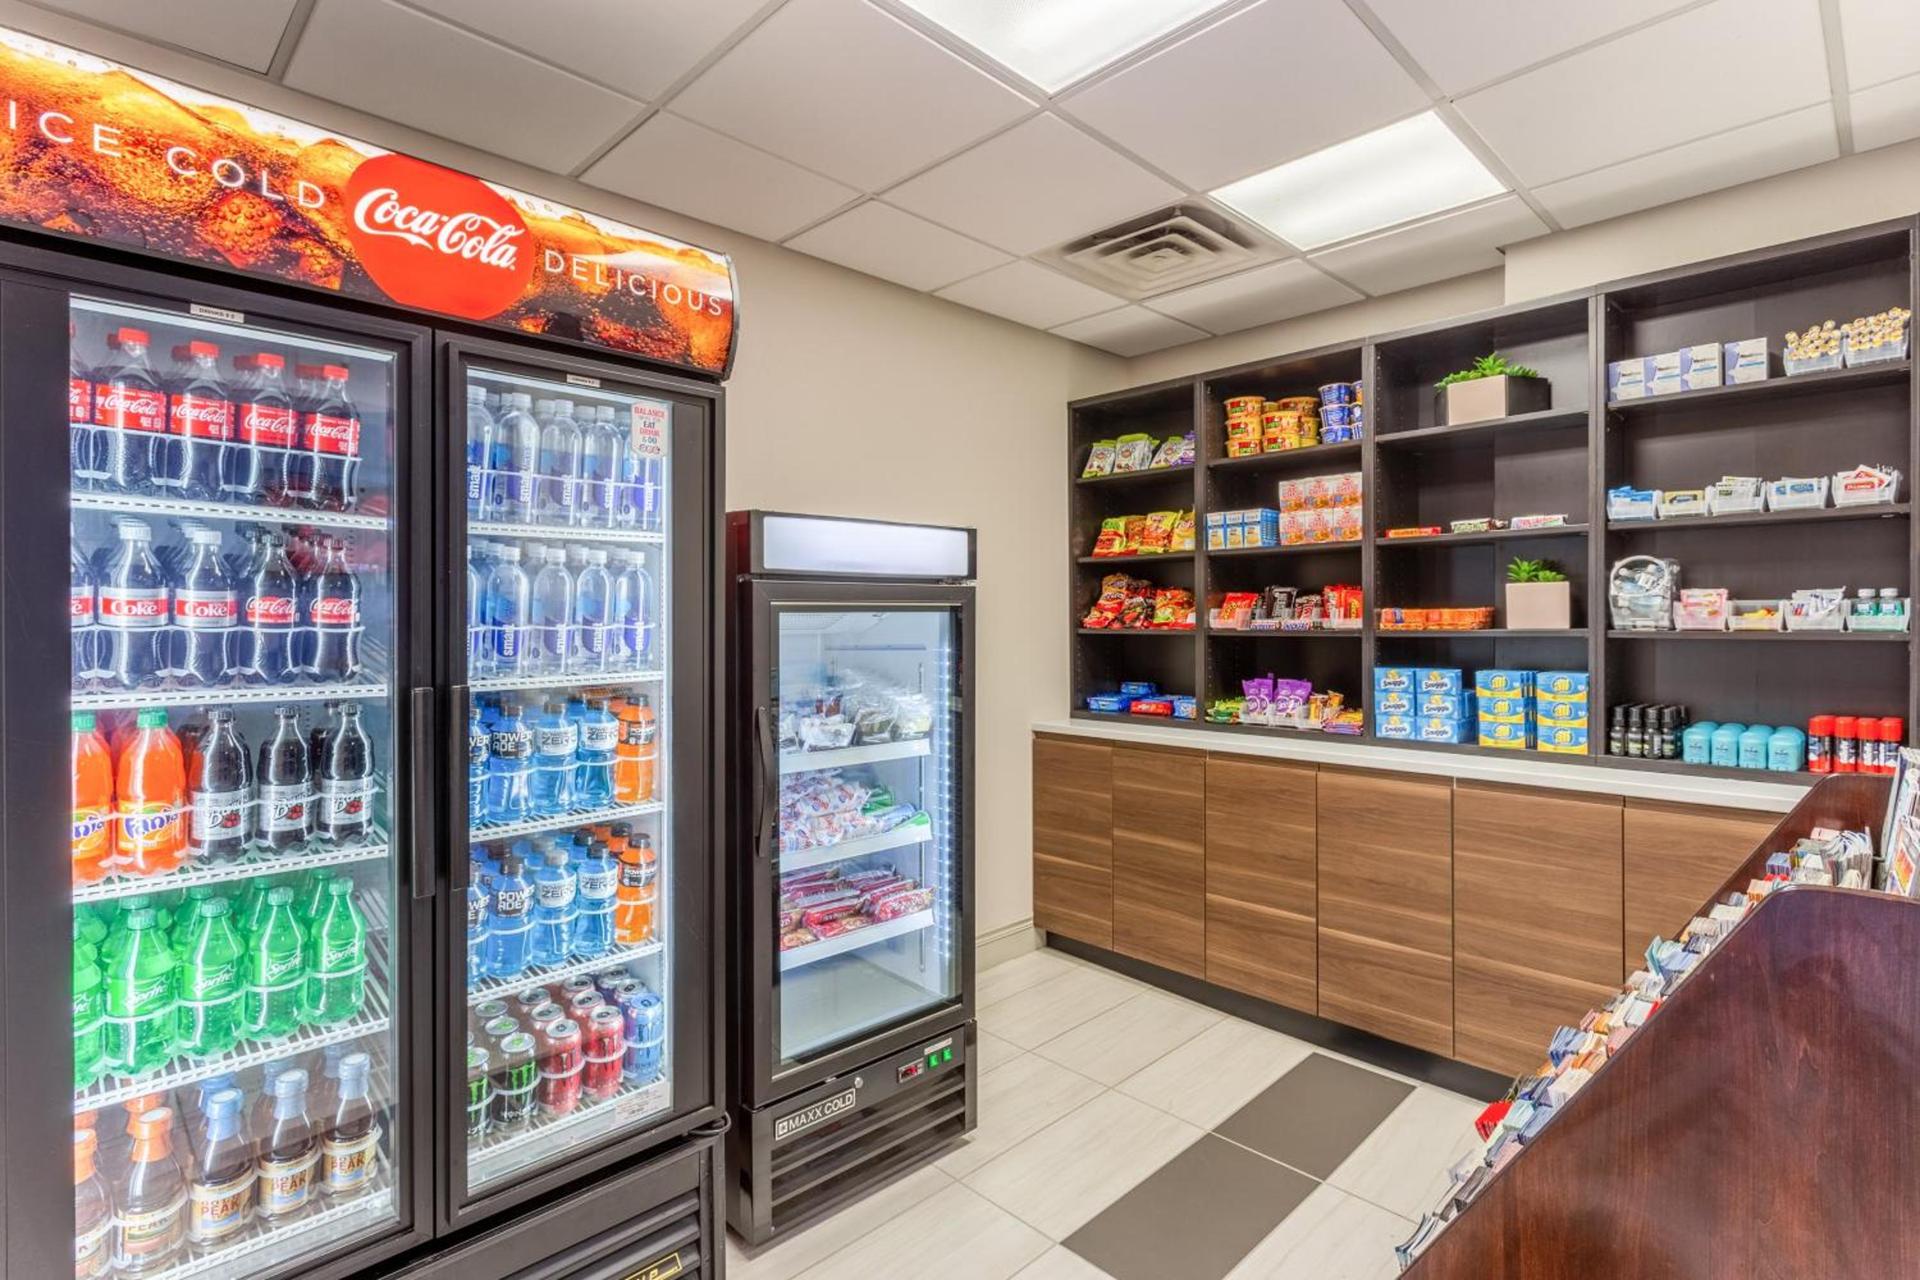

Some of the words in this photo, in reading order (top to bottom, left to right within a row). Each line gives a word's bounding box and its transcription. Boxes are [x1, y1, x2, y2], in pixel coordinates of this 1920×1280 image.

[8, 100, 122, 158] ICE
[166, 146, 326, 209] COLD
[353, 187, 525, 271] Coca-Cola
[543, 249, 724, 317] DELICIOUS
[111, 600, 159, 616] Coke
[185, 600, 228, 617] Coke
[493, 730, 534, 742] POWER
[788, 1106, 823, 1131] MAXX
[824, 1093, 853, 1115] COLD
[330, 1152, 366, 1171] PEAK
[272, 1174, 307, 1190] PEAK
[201, 1198, 240, 1217] PEAK
